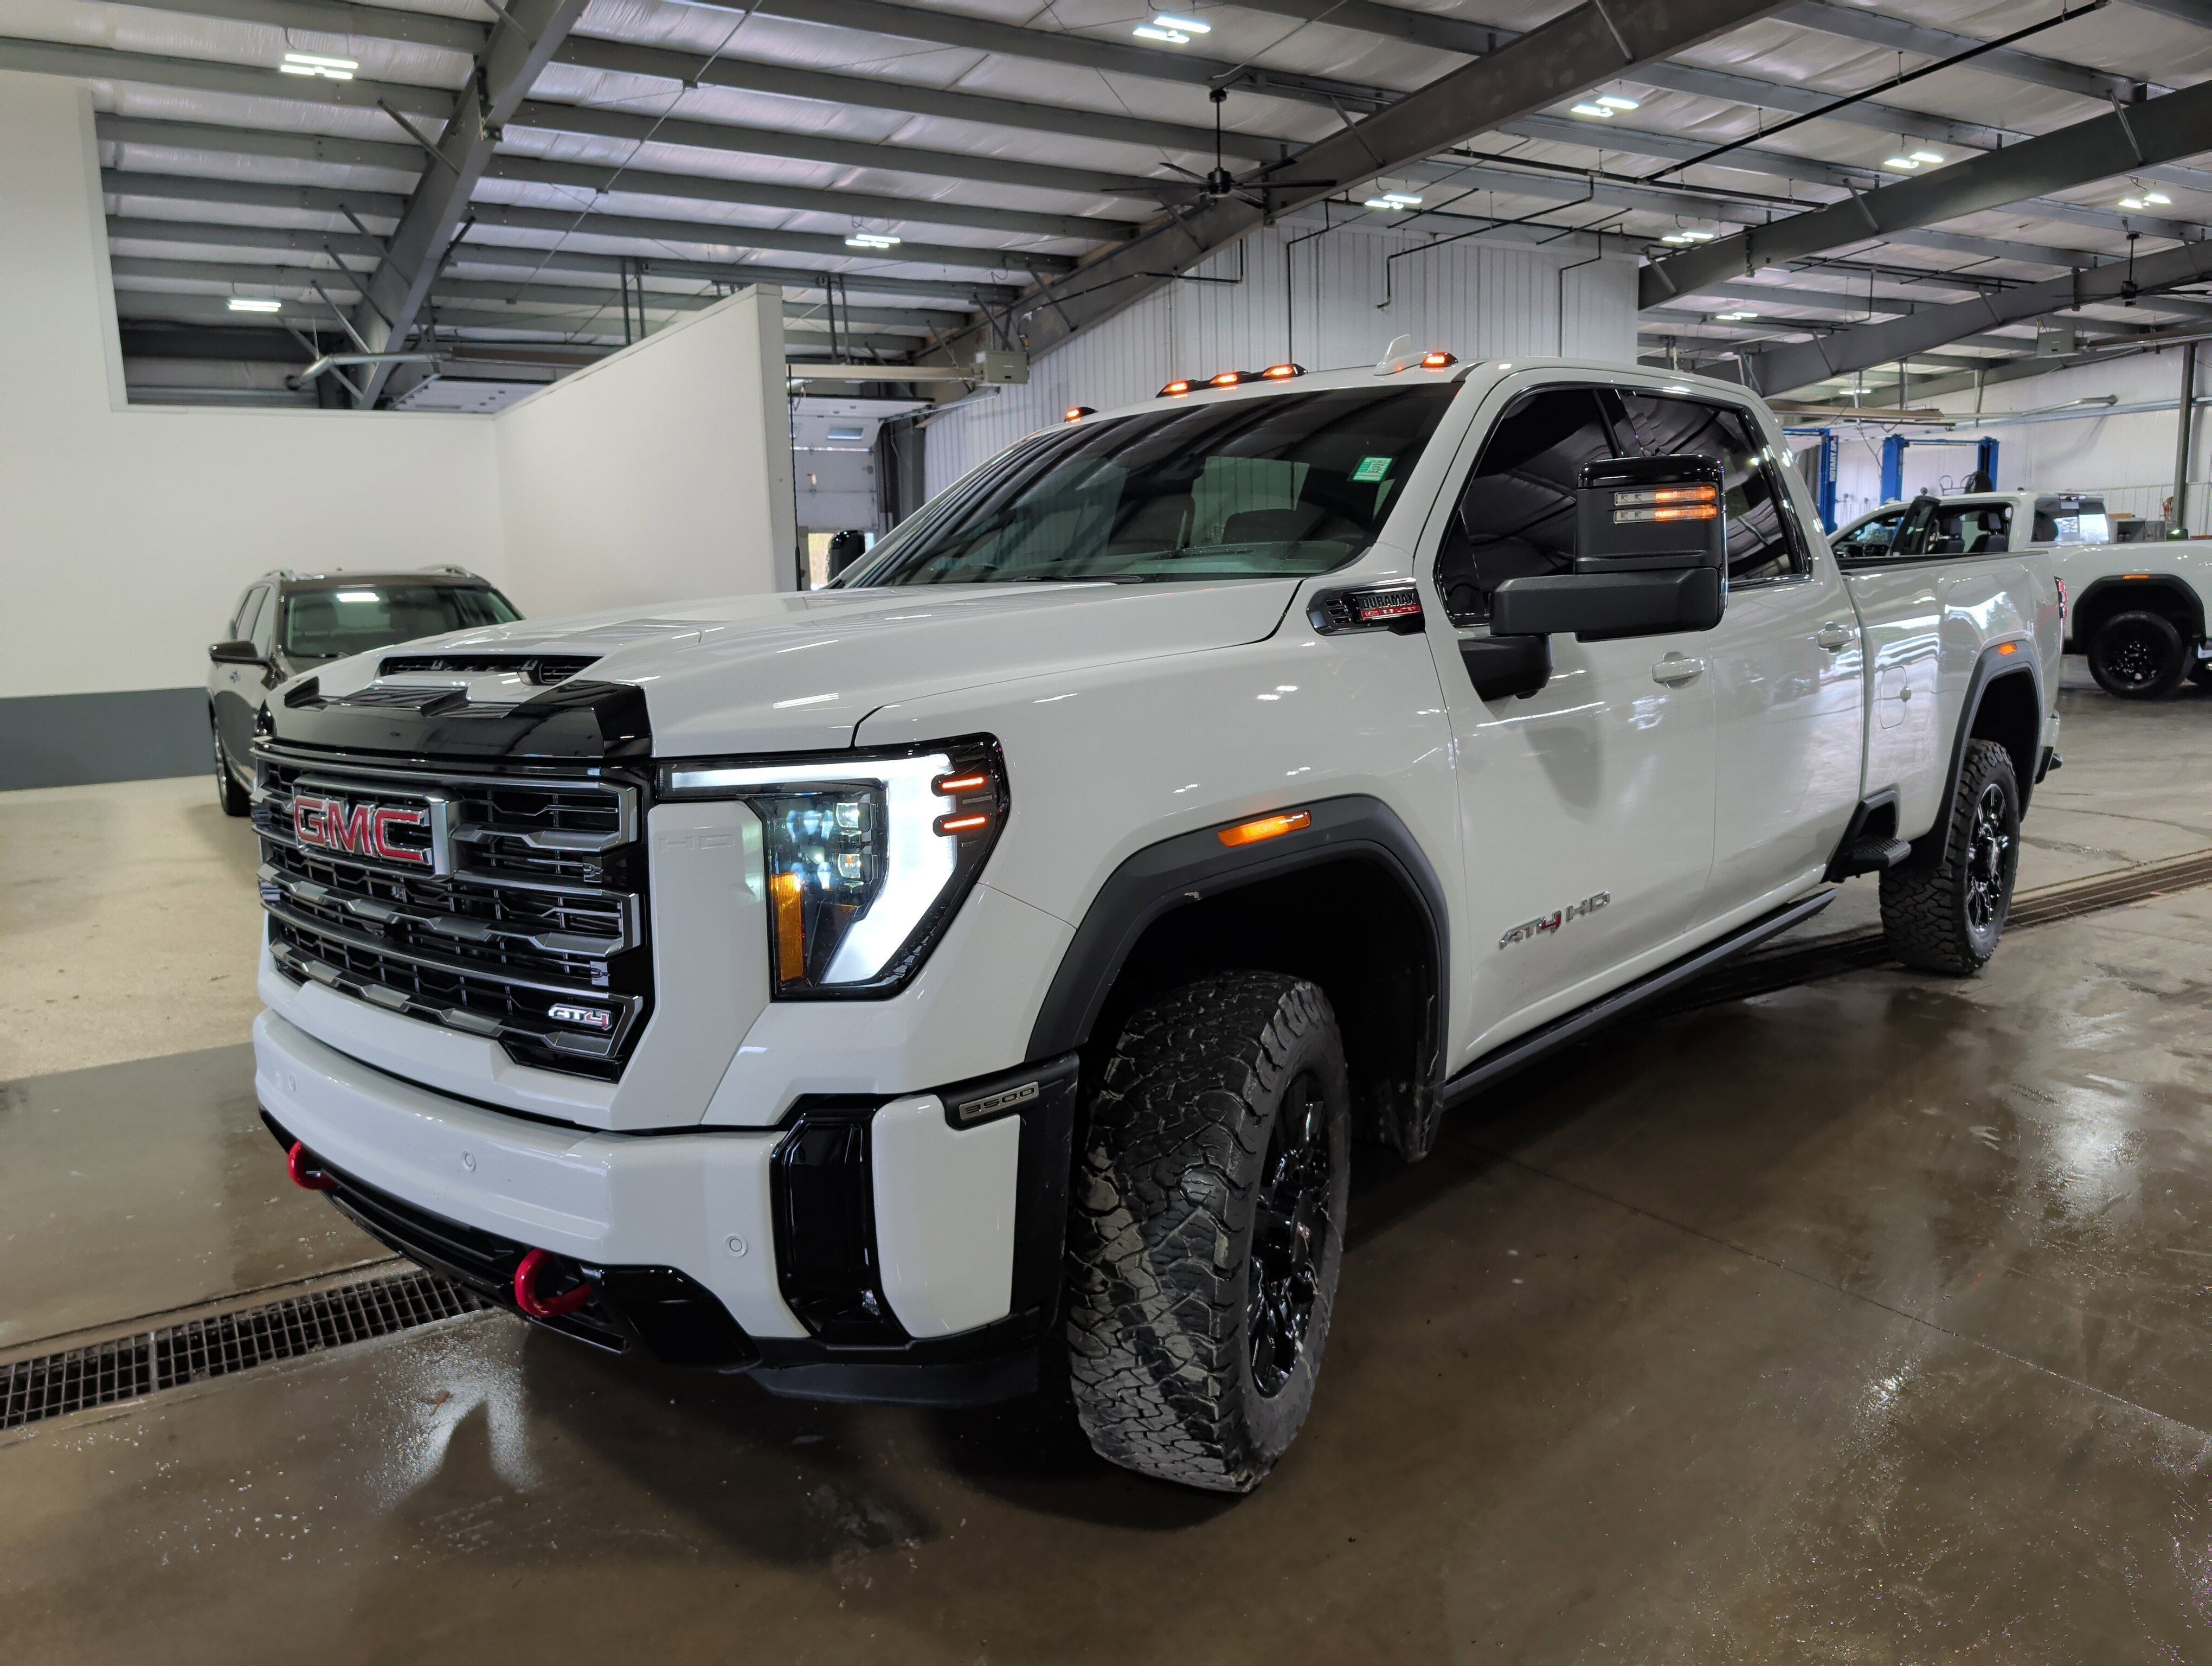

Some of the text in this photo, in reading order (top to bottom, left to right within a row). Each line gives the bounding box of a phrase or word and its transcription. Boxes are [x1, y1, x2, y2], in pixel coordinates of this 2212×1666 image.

[1362, 593, 1416, 609] DURAMAX
[294, 795, 429, 864] GMC
[658, 834, 735, 851] HD
[1498, 890, 1611, 949] AT4 HD
[548, 1005, 611, 1030] AT4
[964, 1087, 1034, 1114] 3500
